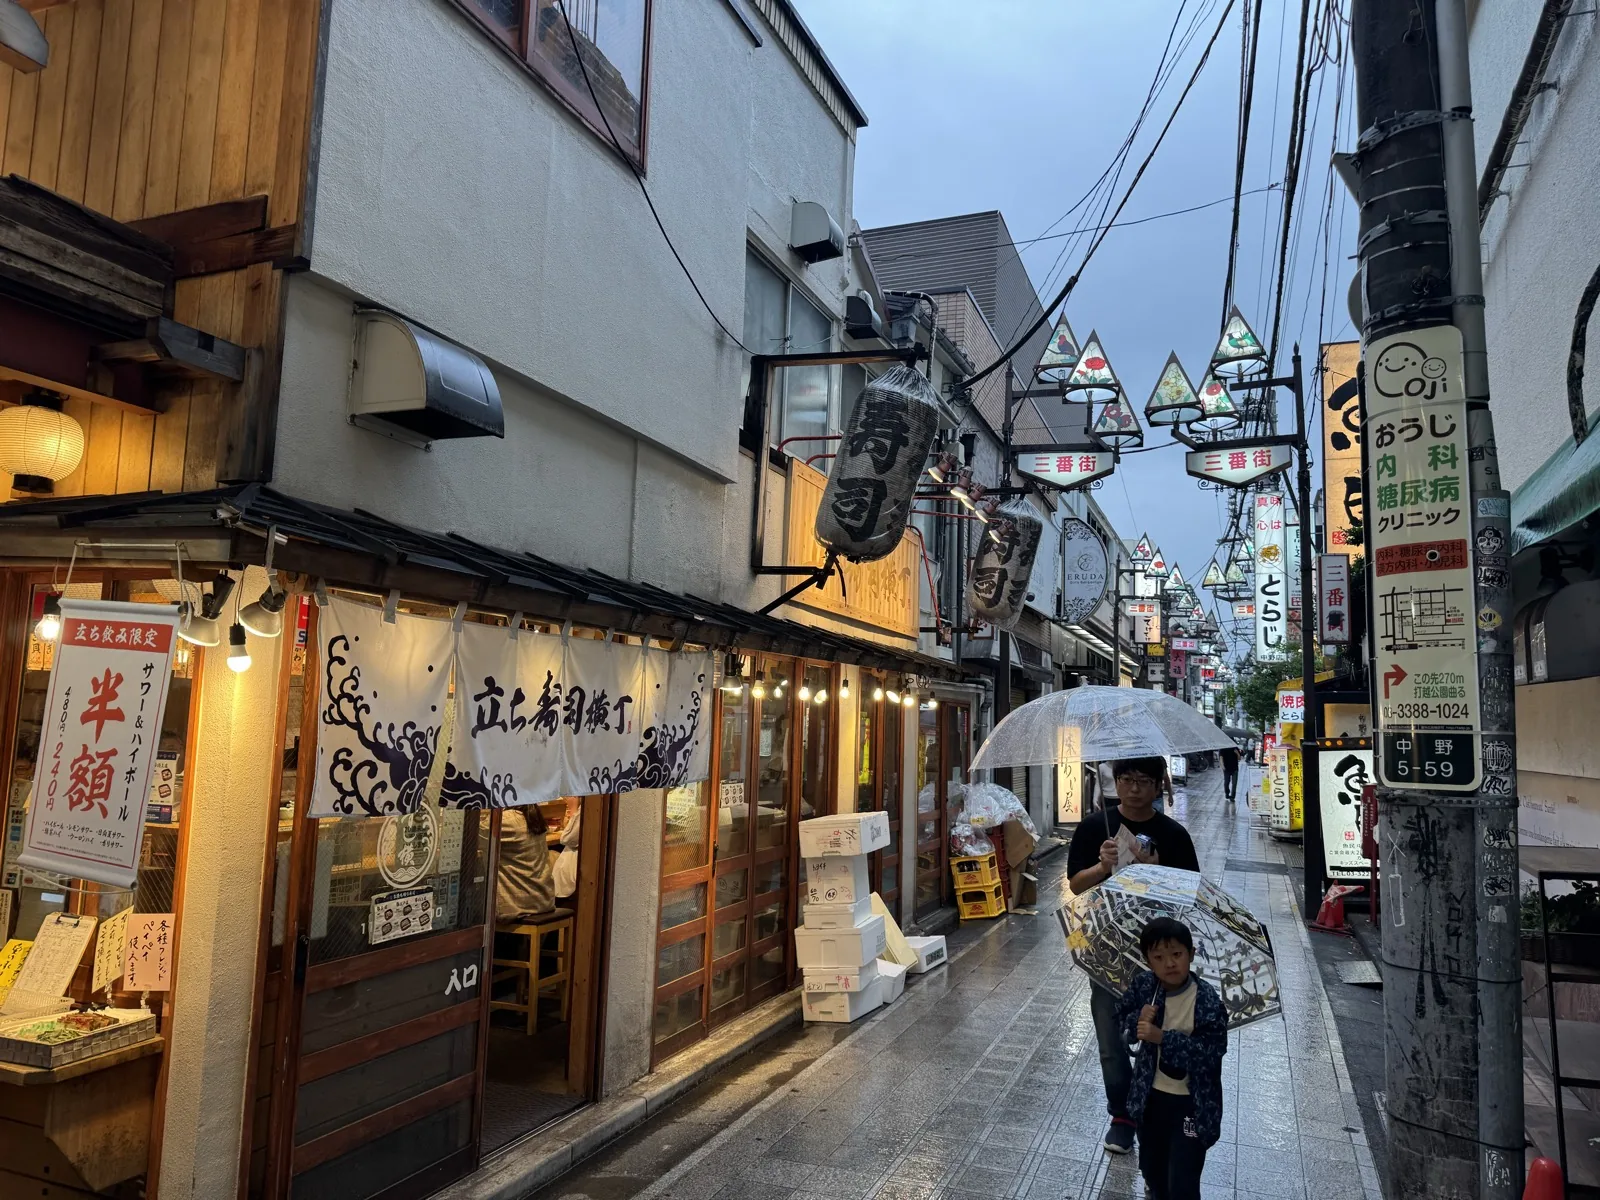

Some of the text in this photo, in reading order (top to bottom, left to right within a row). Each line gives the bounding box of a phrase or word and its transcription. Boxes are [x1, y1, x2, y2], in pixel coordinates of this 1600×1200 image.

[1375, 414, 1456, 448] おうじ
[1033, 455, 1097, 473] 三番街
[1204, 450, 1272, 471] 三番街
[1376, 475, 1460, 511] 糖尿病
[1378, 507, 1461, 533] クリニック
[1260, 574, 1282, 648] とらじ
[74, 626, 159, 648] 立ち飲み限定
[1413, 672, 1465, 684] この先270m
[1413, 686, 1466, 699] 打越公園曲る
[1384, 703, 1469, 719] 03-3388-1024
[62, 667, 125, 819] 半額
[118, 662, 155, 822] サワー&ハイボール
[1396, 738, 1453, 755] 中野
[1397, 761, 1454, 777] 5-59
[1273, 775, 1285, 811] とらじ
[142, 921, 154, 962] ペイペイ
[445, 963, 477, 995] 入口
